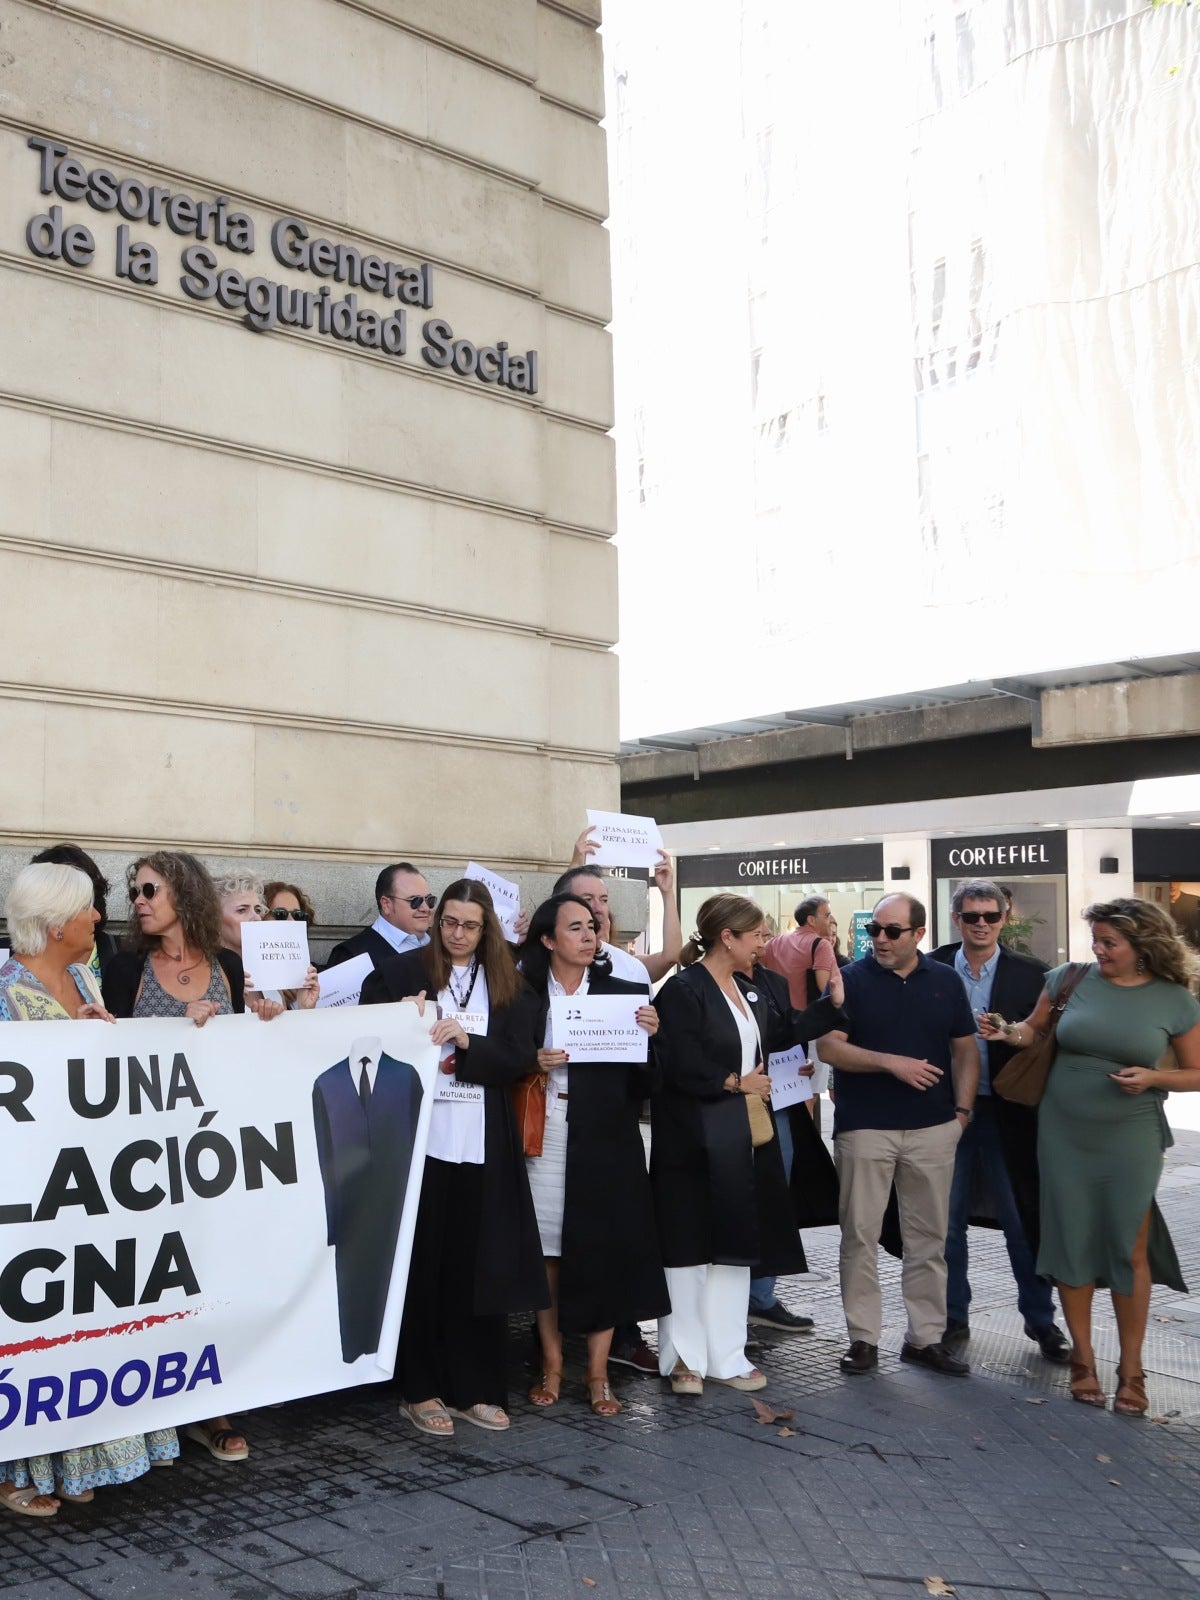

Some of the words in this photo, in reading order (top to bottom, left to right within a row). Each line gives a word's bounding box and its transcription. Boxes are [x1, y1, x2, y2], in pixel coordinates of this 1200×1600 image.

[28, 136, 255, 255] Tesorería
[272, 214, 434, 309] General
[27, 205, 95, 268] de
[116, 223, 159, 284] la
[182, 244, 407, 357] Seguridad
[423, 318, 539, 395] Social
[602, 835, 627, 843] RETA
[949, 844, 1049, 867] CORTEFIEL
[738, 857, 809, 877] CORTEFIEL
[262, 953, 285, 961] RETA
[466, 1014, 485, 1022] RETA
[67, 1052, 204, 1119] UNA
[439, 1091, 481, 1099] MUTUALIDAD
